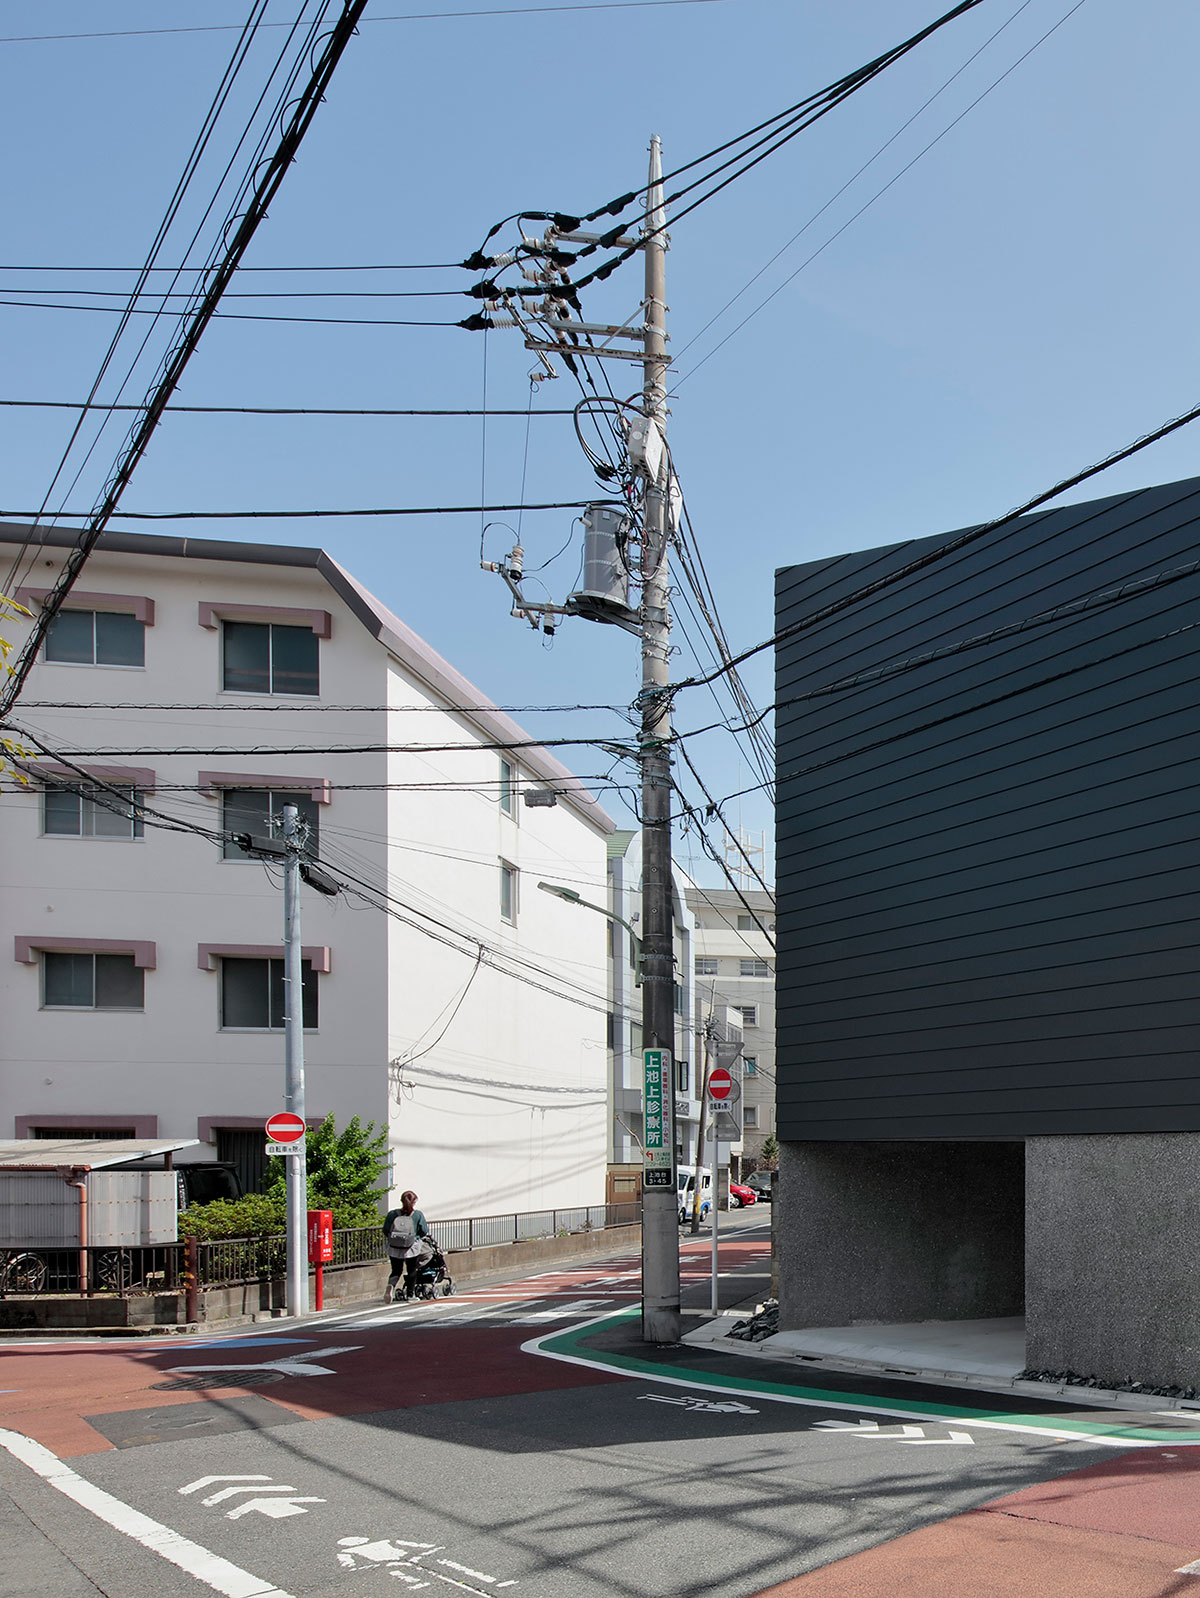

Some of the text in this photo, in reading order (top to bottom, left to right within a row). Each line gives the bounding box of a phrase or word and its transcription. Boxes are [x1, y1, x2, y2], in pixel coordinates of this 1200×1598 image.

[646, 1055, 661, 1145] 上池上診療所
